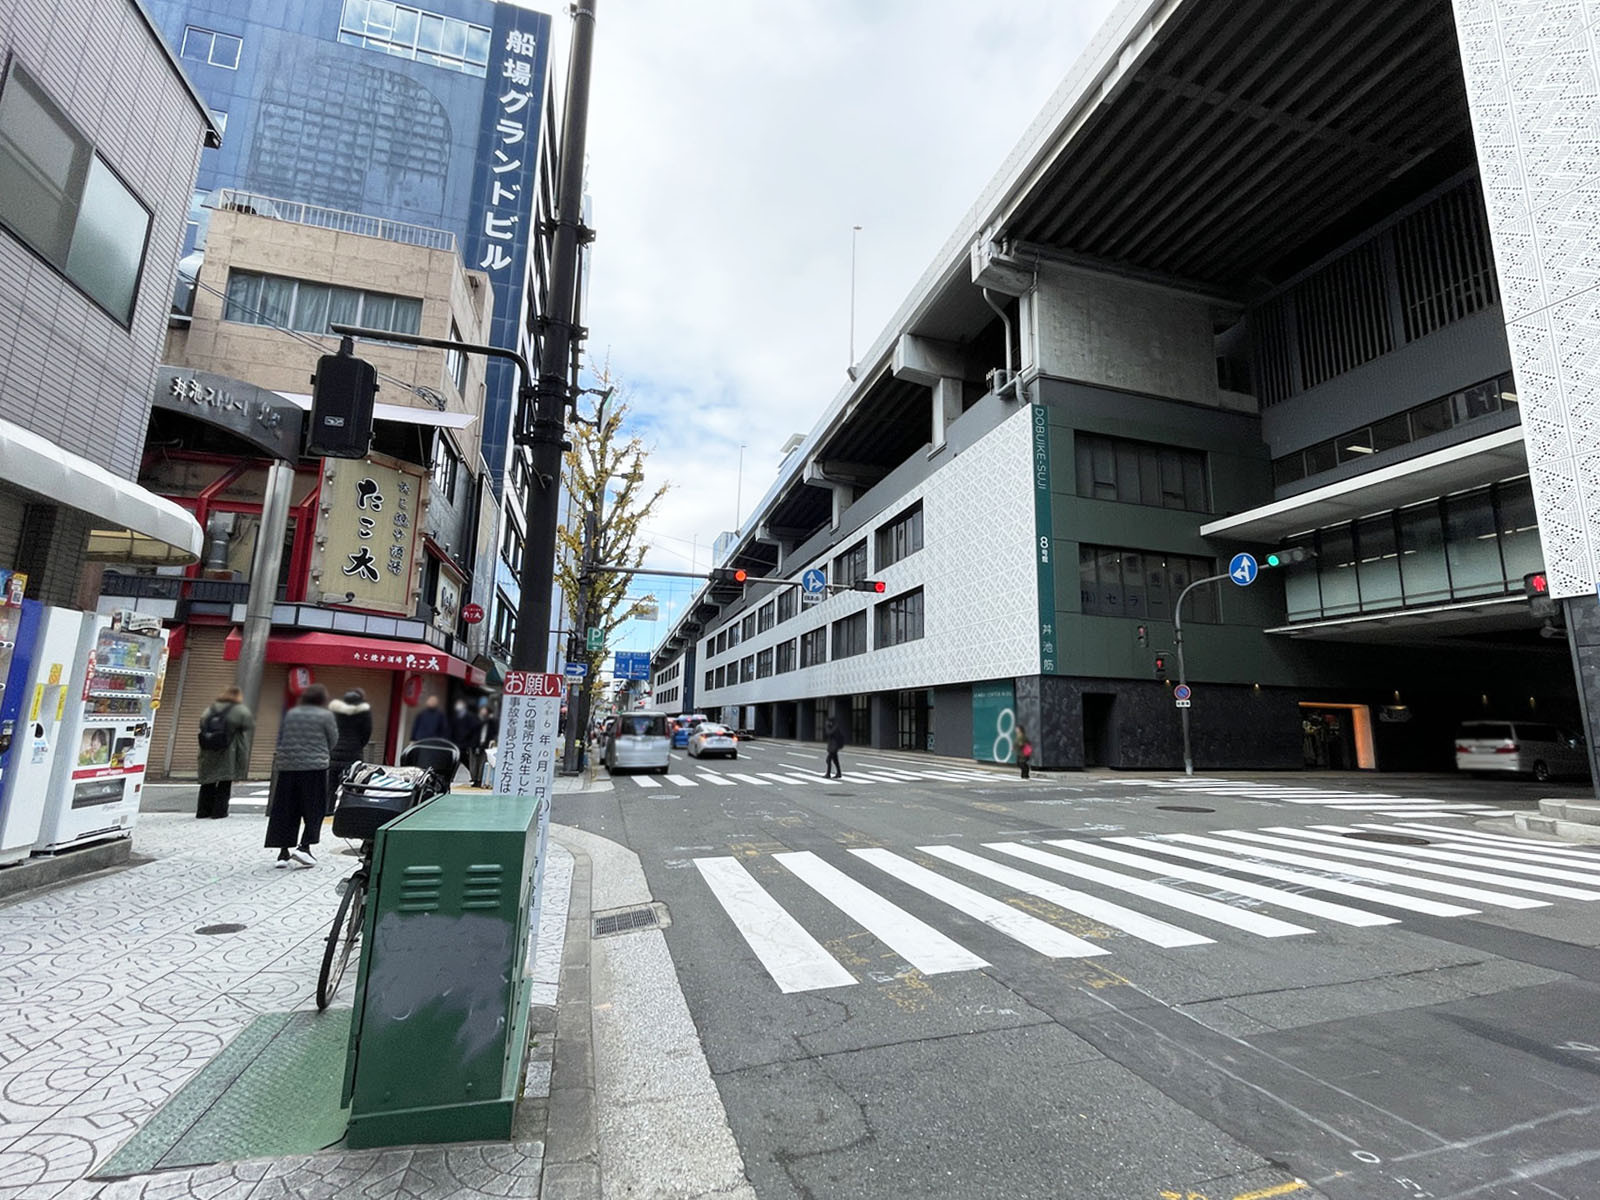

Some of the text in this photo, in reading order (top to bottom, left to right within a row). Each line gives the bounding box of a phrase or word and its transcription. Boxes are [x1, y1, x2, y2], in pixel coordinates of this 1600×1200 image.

[479, 30, 536, 272] 船場グランドビル
[1034, 407, 1047, 490] DOBUIKE-SUJI
[342, 477, 385, 583] たこ太
[405, 653, 440, 671] たこ太
[592, 628, 602, 642] P
[505, 672, 563, 696] お願い
[499, 697, 521, 794] 事故を見られた方は
[517, 697, 537, 797] この場所で発生した
[993, 708, 1016, 762] 8
